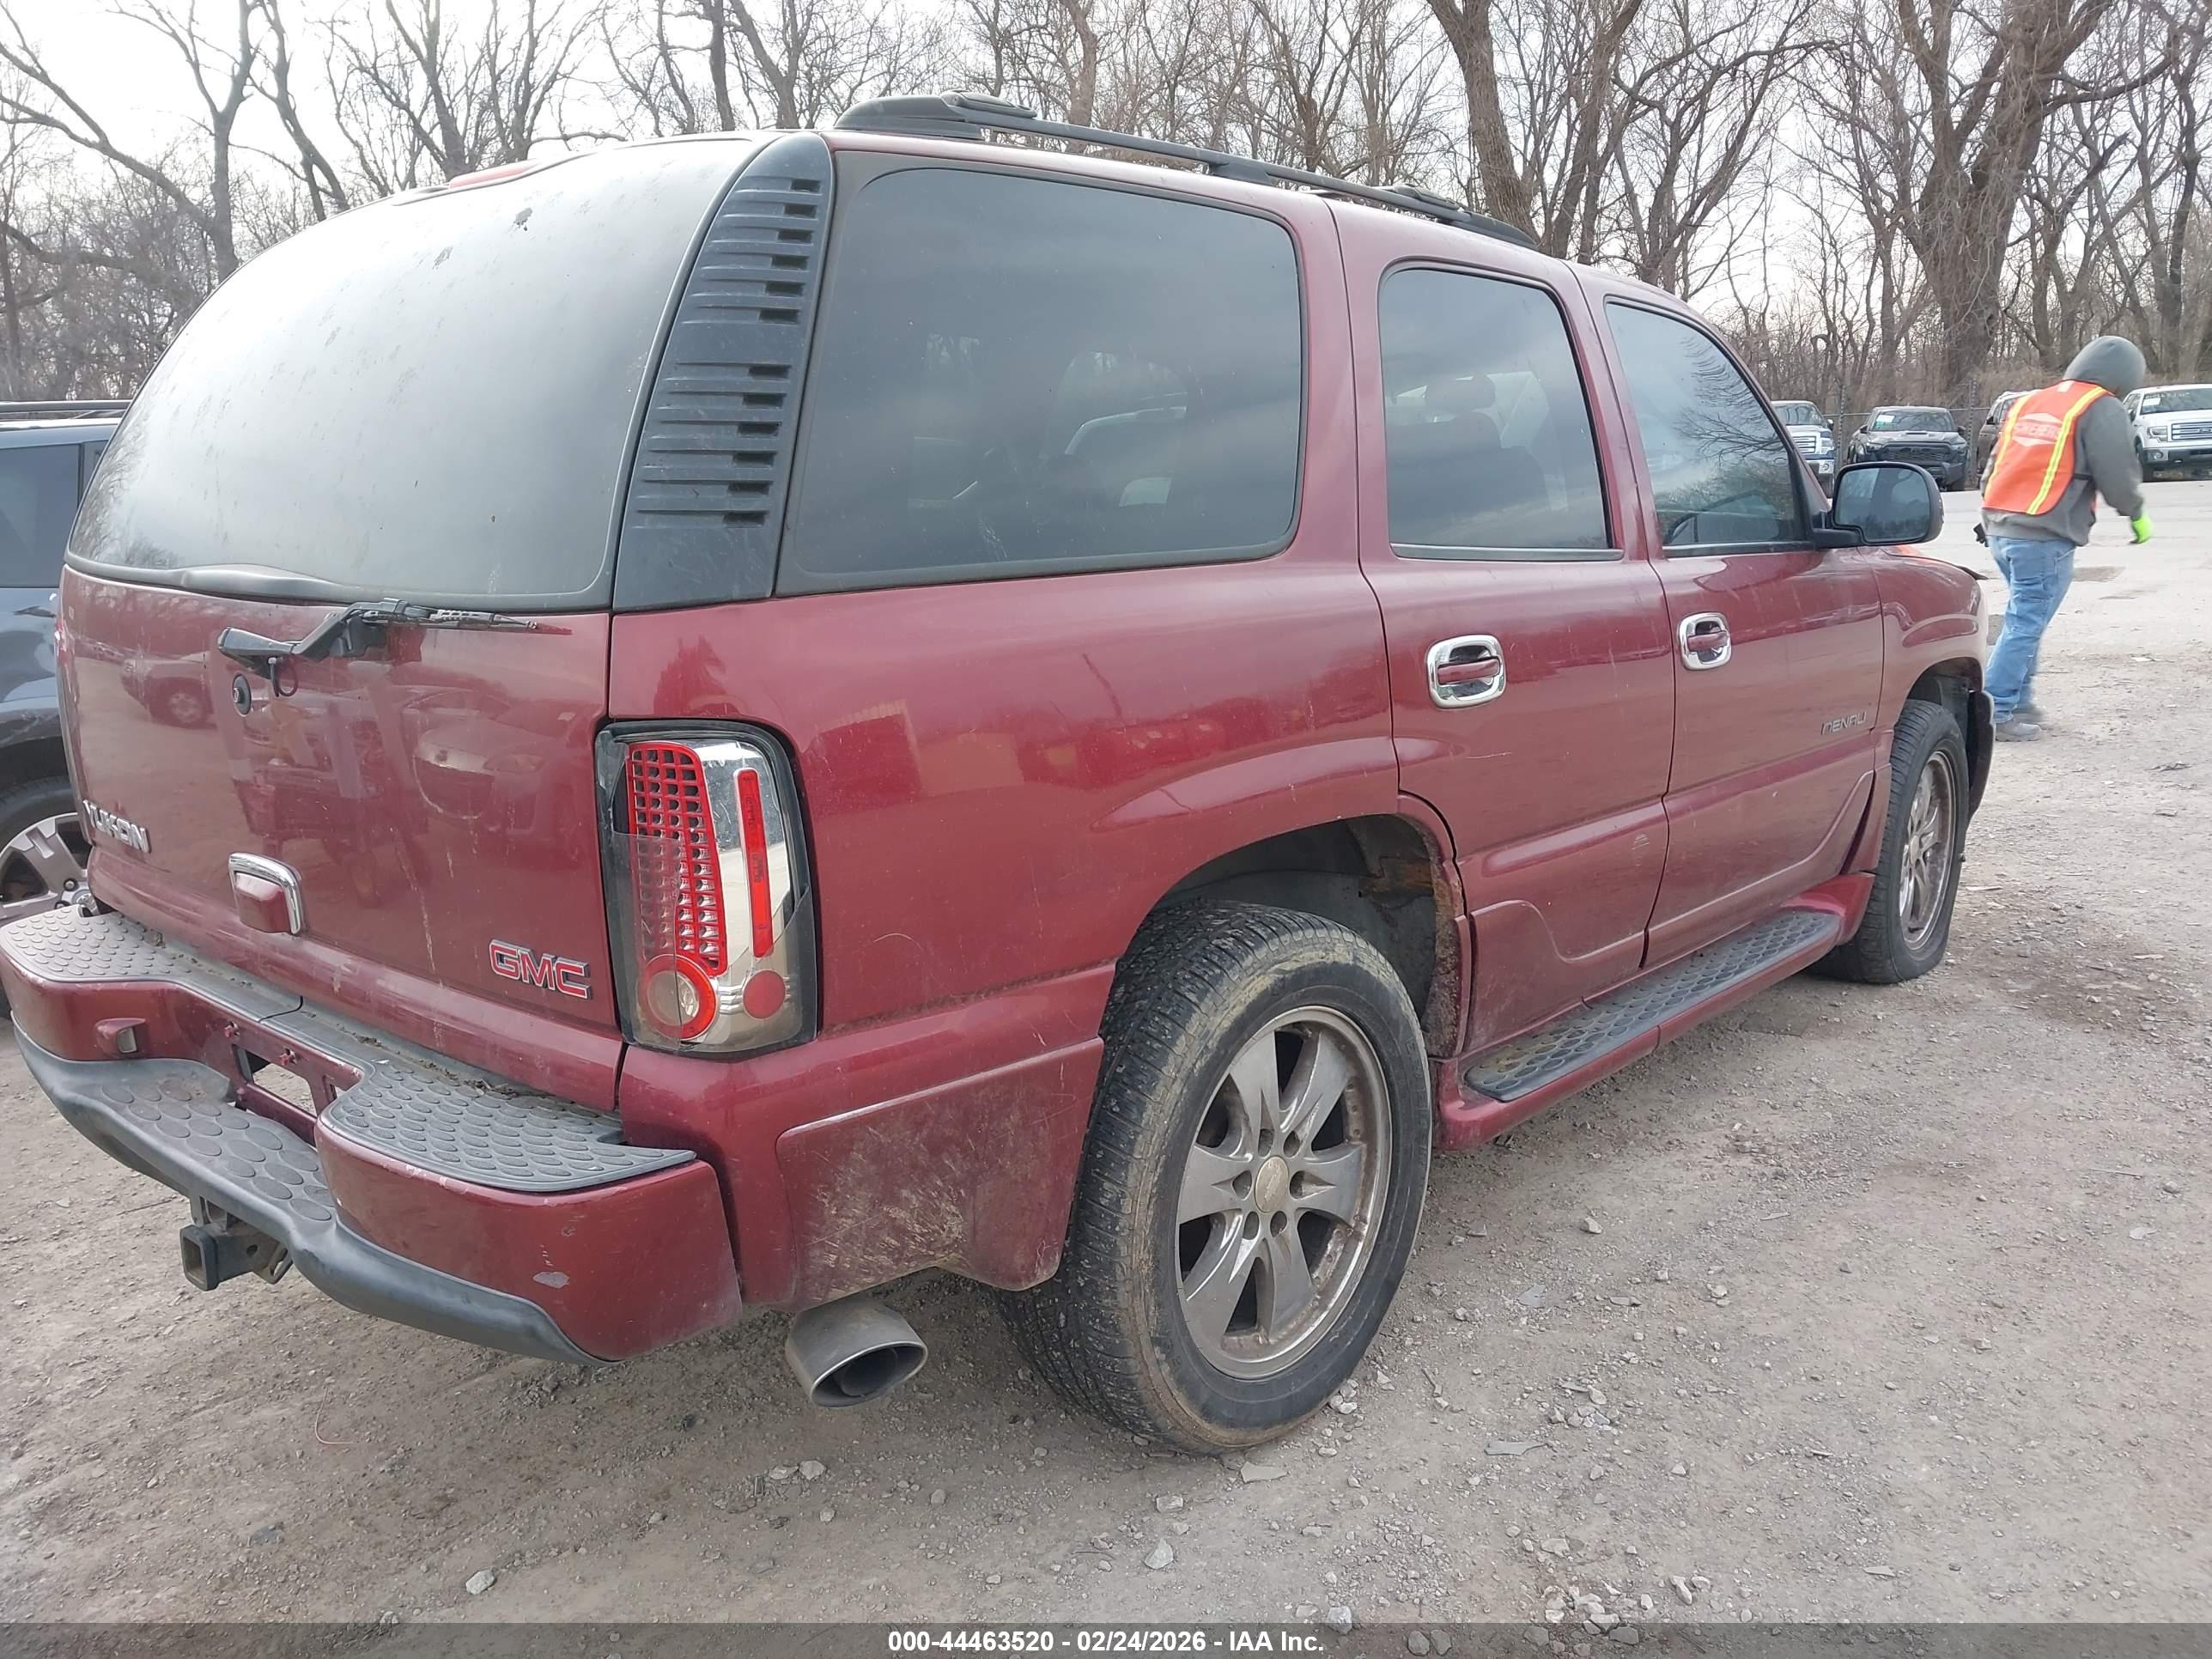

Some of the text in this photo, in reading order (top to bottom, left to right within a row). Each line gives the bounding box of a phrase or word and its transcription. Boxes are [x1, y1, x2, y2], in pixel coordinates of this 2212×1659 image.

[1821, 710, 1867, 736] DENALI
[82, 799, 150, 854] YUKON
[489, 939, 591, 1000] GMC
